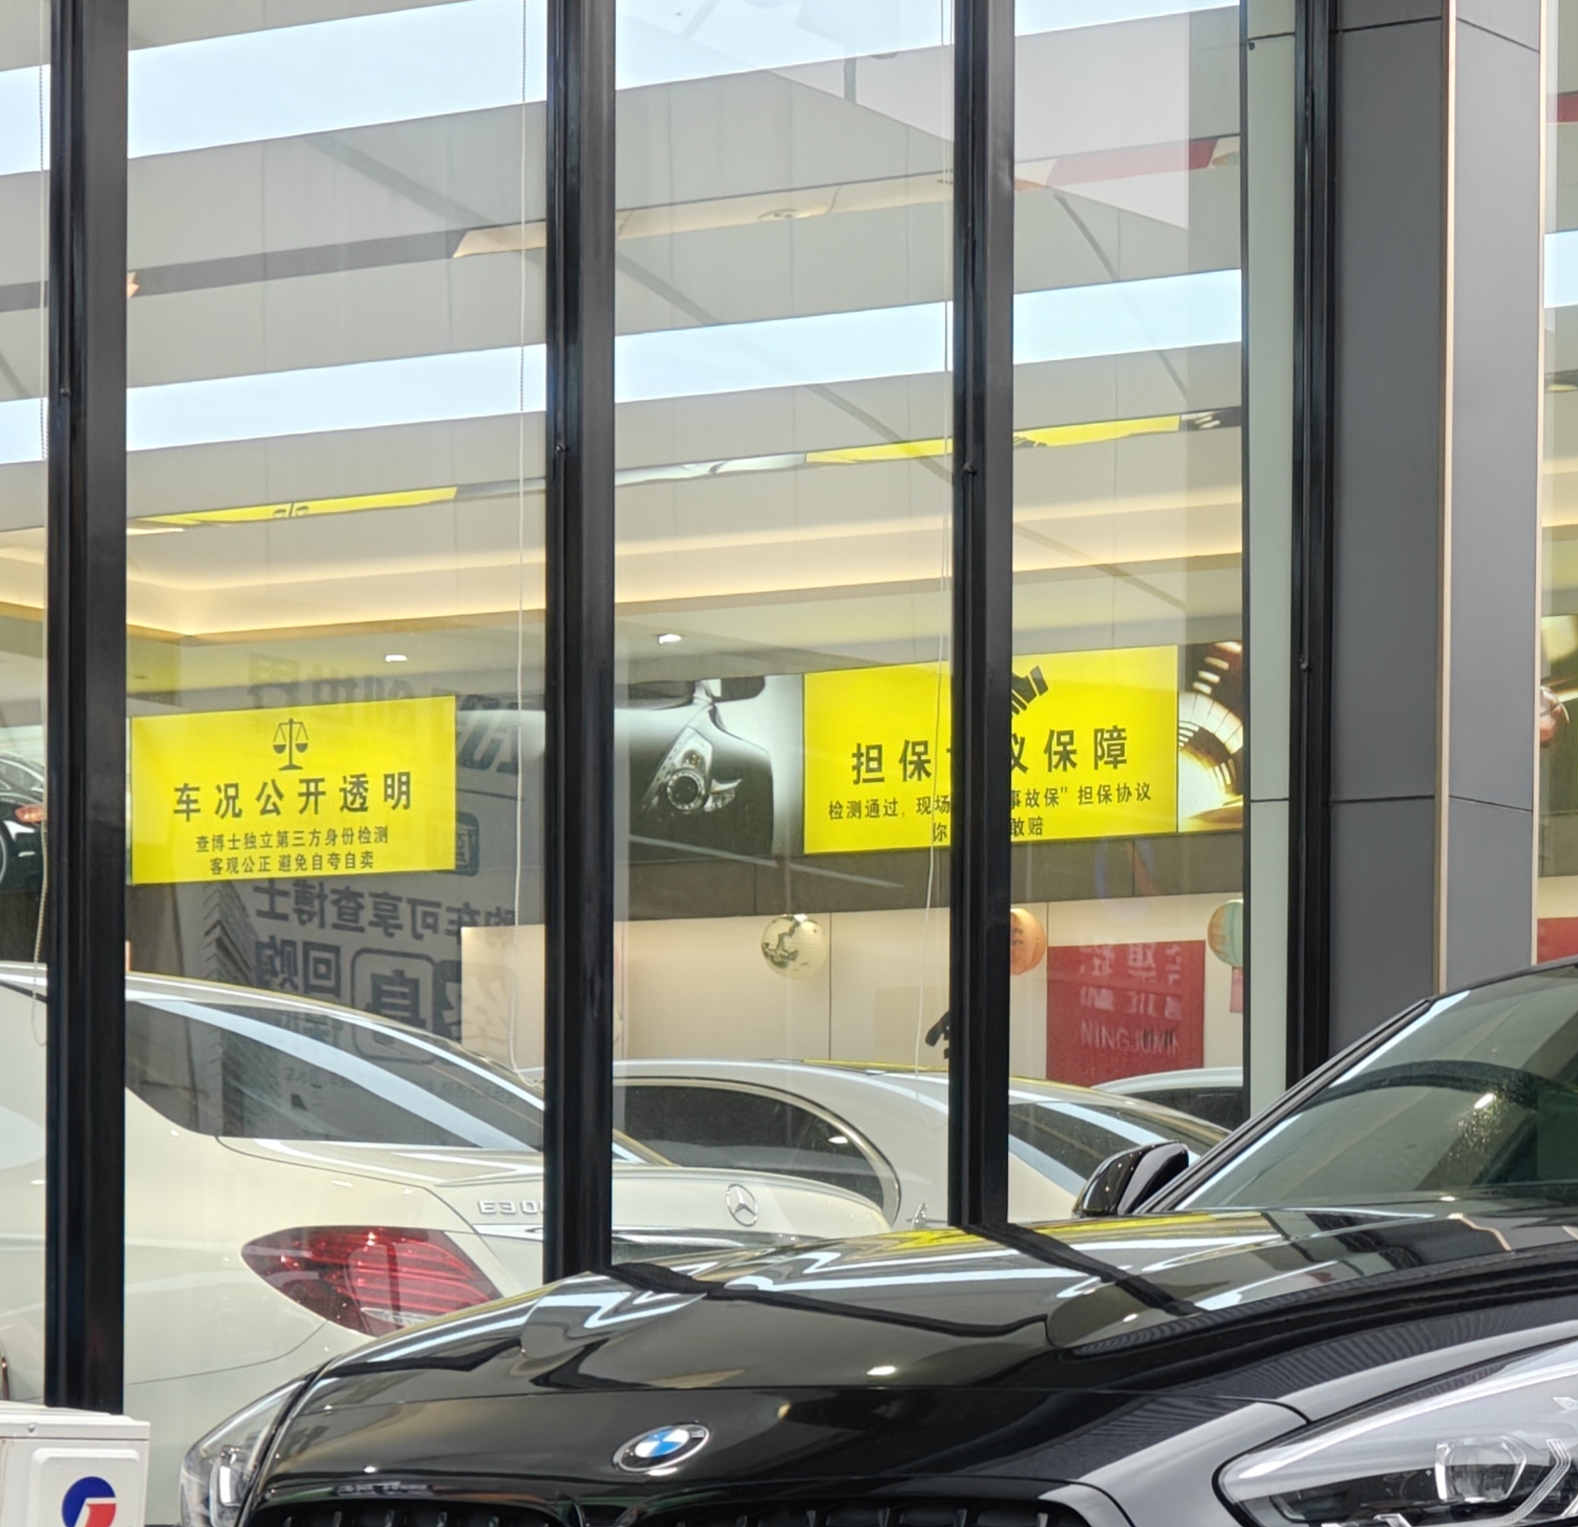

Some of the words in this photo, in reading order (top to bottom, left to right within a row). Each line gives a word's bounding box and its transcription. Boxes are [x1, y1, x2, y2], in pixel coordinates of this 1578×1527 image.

[173, 771, 412, 822] 车况公开透明
[195, 825, 389, 853] 查博士独立第三方身份检测
[209, 855, 272, 876] 客观公正
[277, 850, 375, 872] 避免自夸自卖
[477, 1199, 544, 1216] E30
